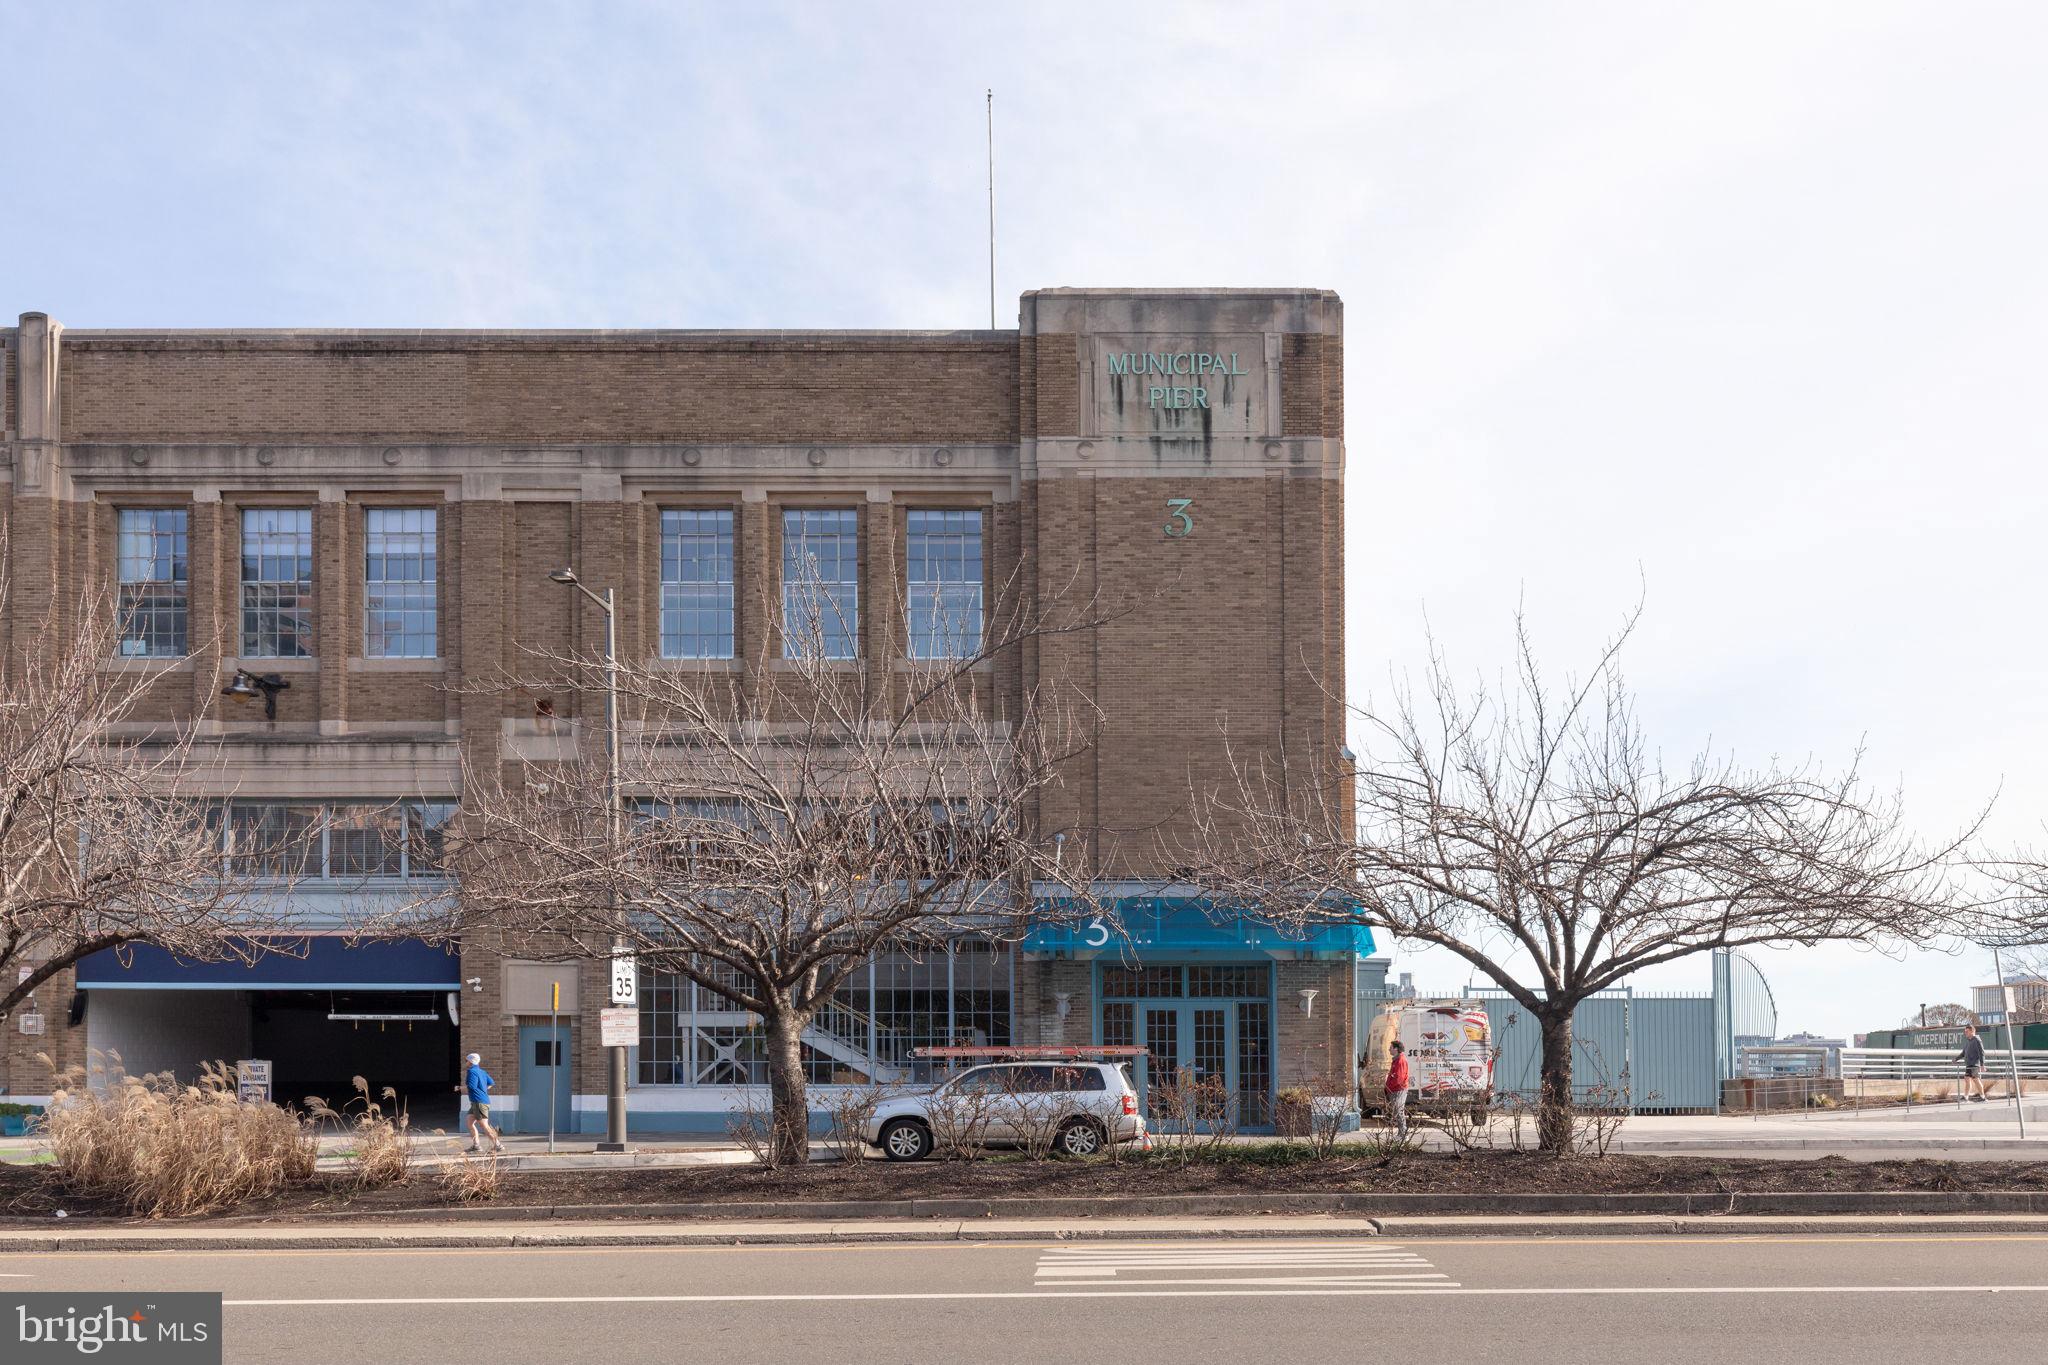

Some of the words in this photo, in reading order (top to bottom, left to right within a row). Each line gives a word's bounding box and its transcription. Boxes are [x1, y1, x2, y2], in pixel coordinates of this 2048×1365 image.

[1108, 353, 1249, 375] MUNICIPAL
[1150, 387, 1210, 409] PIER
[1164, 499, 1194, 537] 3
[1085, 914, 1109, 946] 3
[616, 977, 632, 997] 35
[1914, 1032, 1964, 1046] INDEPENDENT
